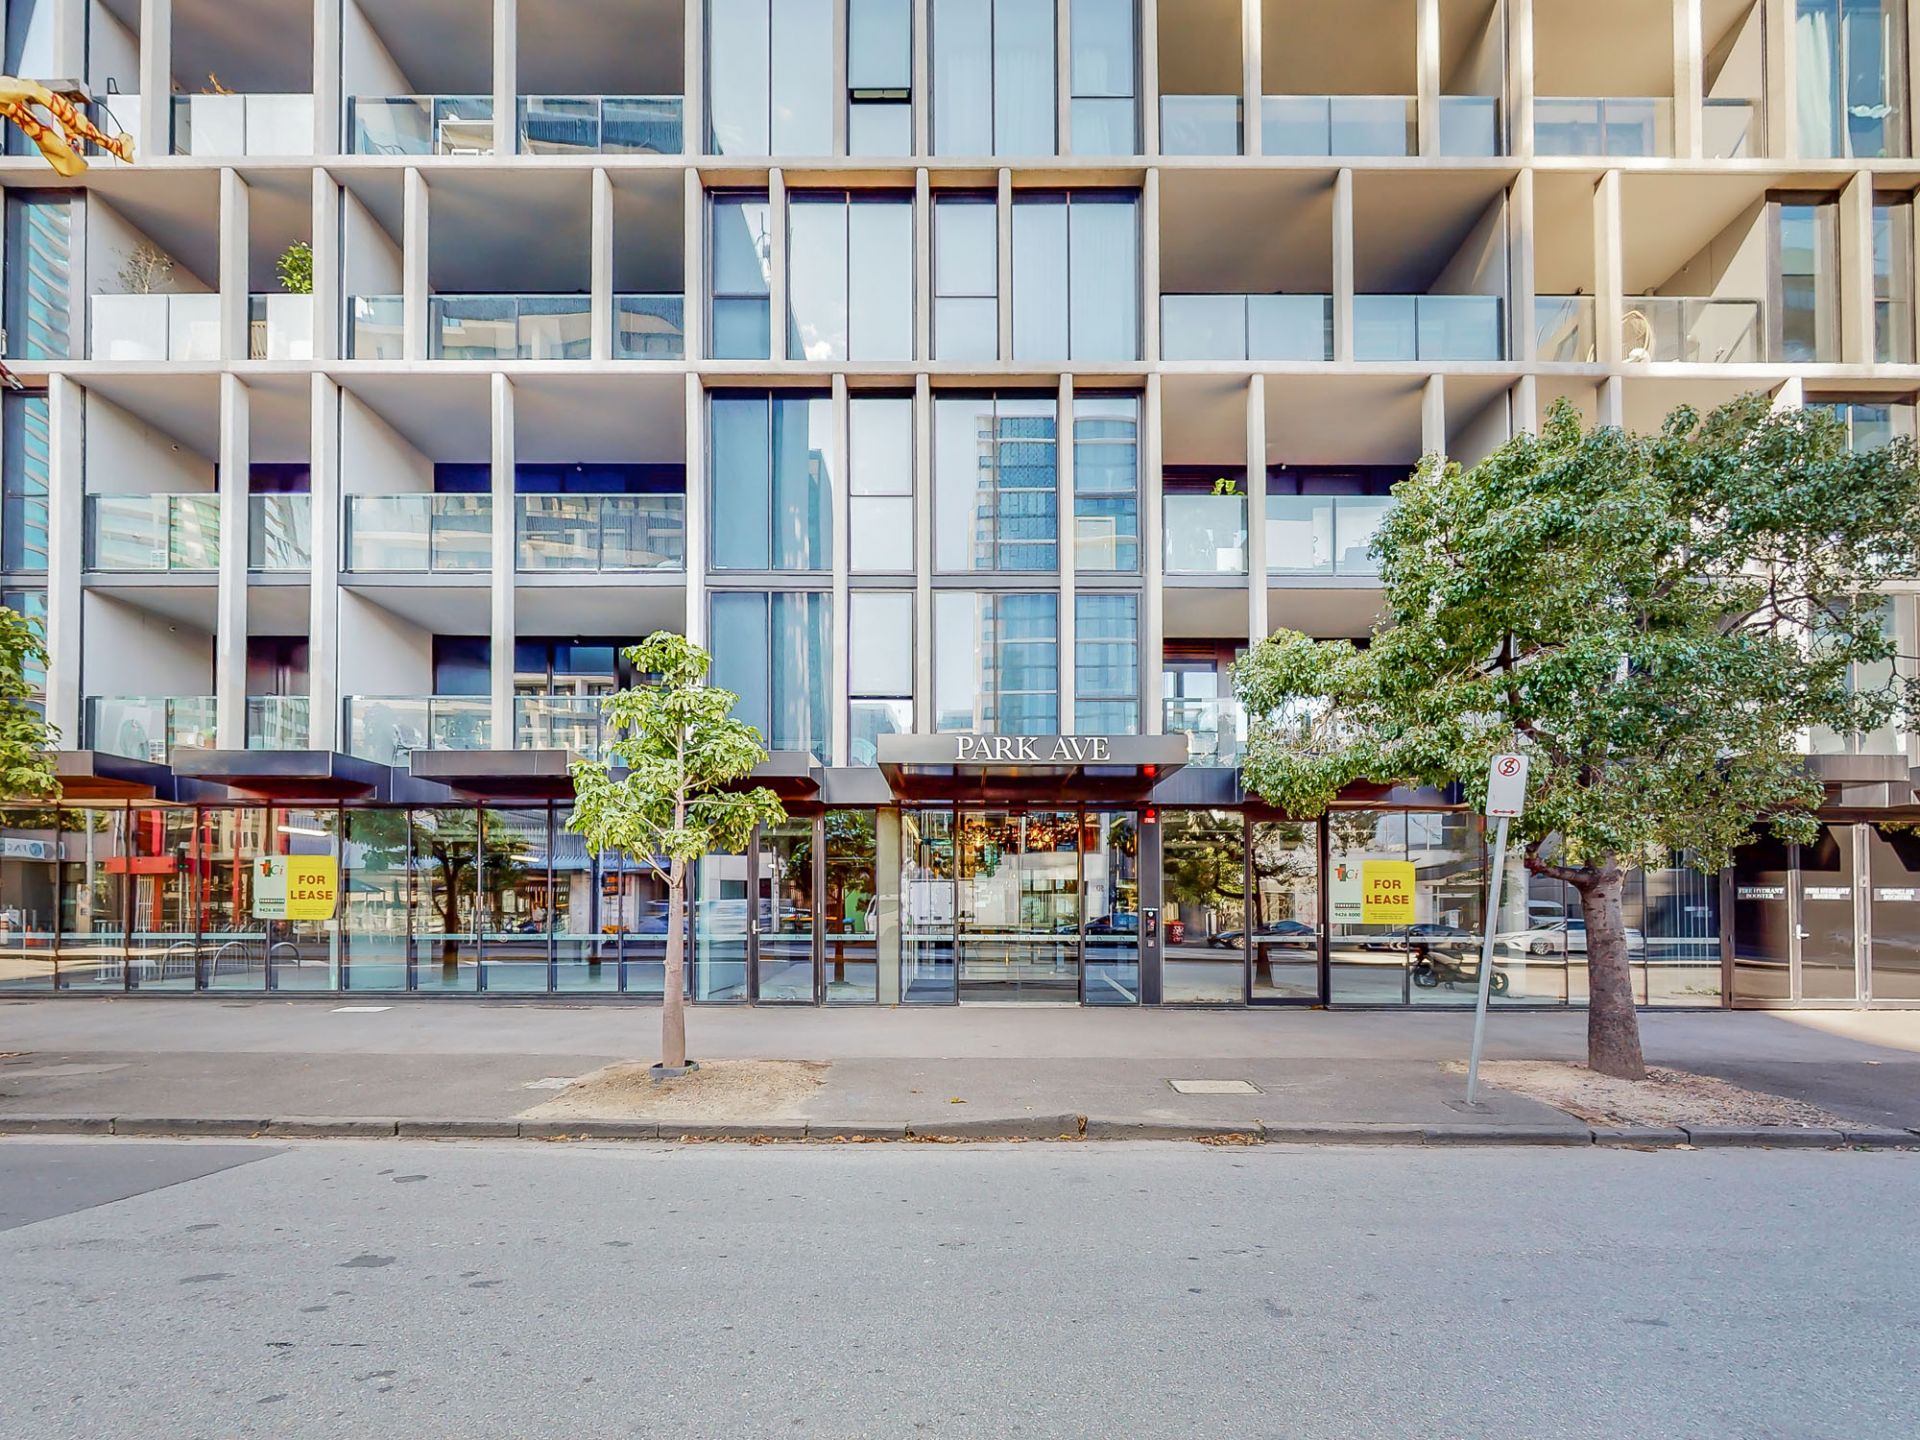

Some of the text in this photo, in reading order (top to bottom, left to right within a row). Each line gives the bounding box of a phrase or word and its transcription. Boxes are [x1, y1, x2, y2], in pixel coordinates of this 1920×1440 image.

[955, 736, 1111, 761] PARK AVE
[298, 875, 326, 885] FOR
[1373, 879, 1402, 889] FOR
[290, 890, 334, 900] LEASE
[1366, 894, 1409, 905] LEASE
